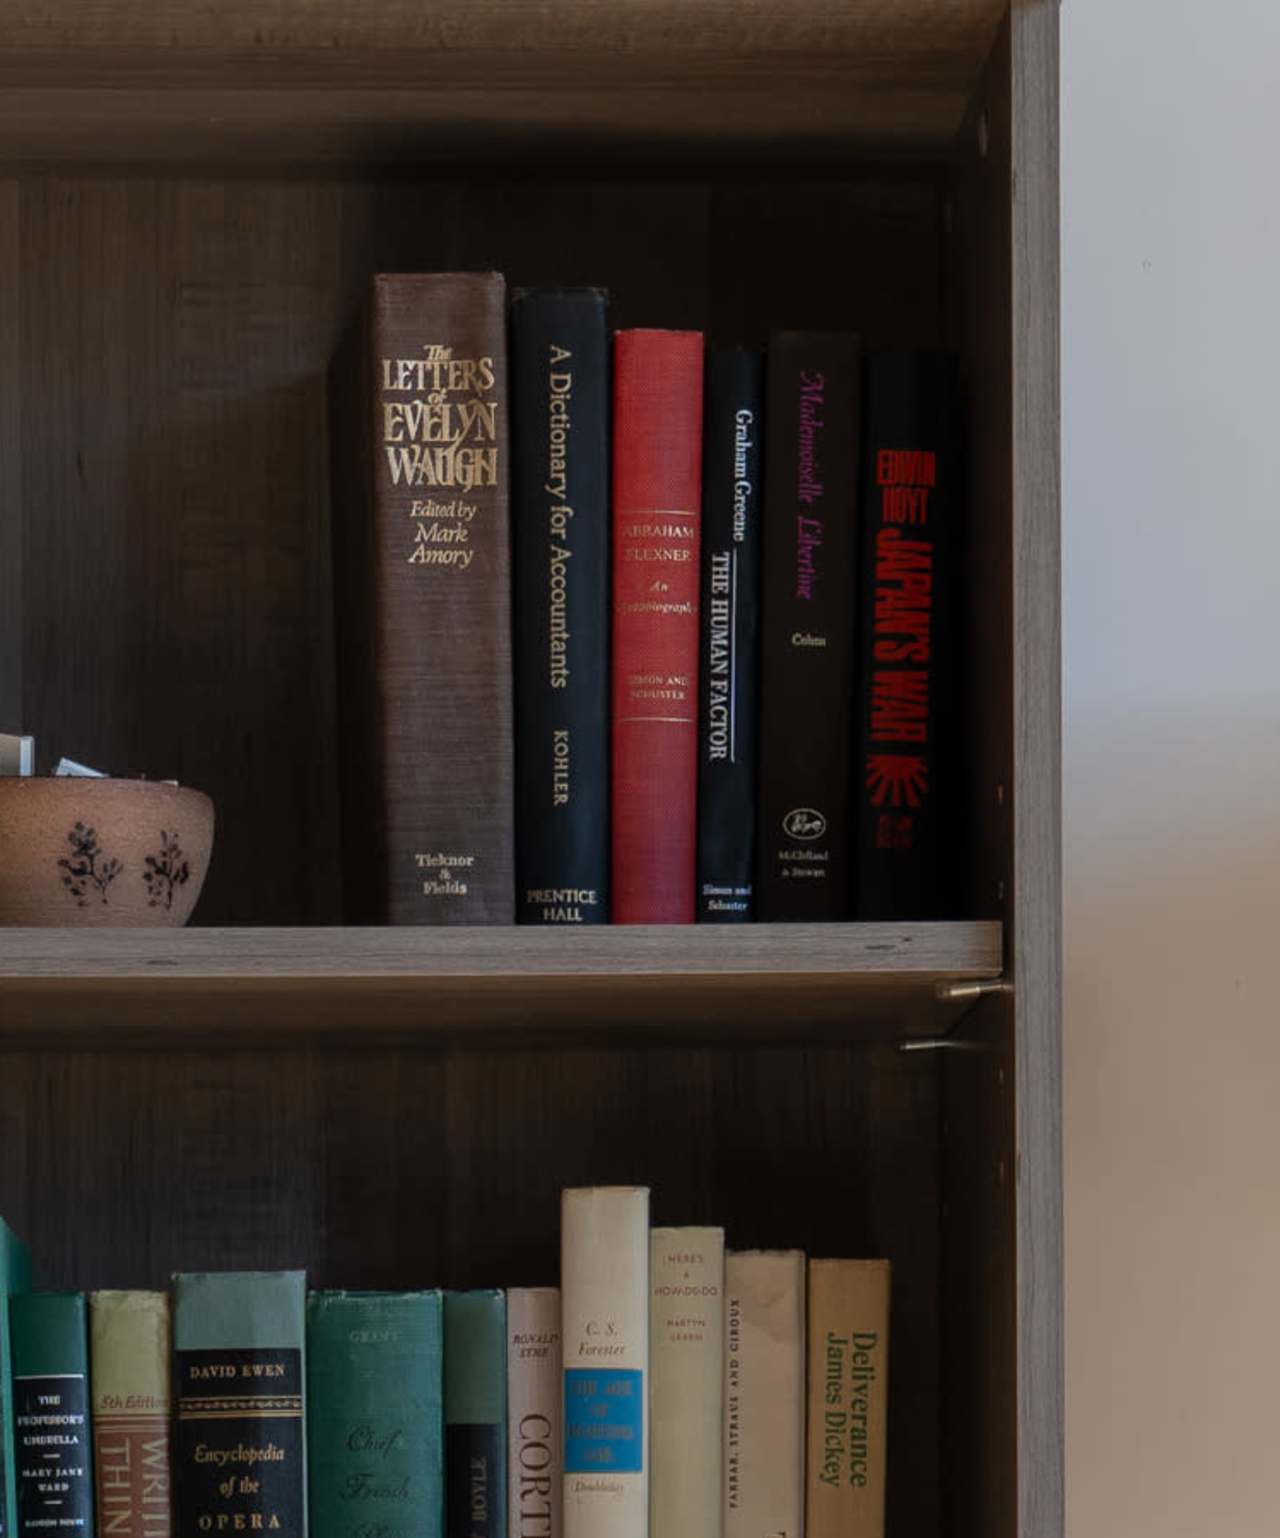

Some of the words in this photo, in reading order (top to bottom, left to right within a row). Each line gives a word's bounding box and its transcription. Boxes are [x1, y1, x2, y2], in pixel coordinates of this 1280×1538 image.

[423, 344, 454, 361] The
[549, 345, 572, 363] A
[381, 357, 496, 395] LETTERS
[382, 400, 498, 446] EVELYN
[544, 373, 572, 500] Dictionary
[735, 409, 752, 478] Graham
[798, 370, 824, 504] Mademoiselle
[385, 445, 499, 492] WAUGH
[409, 500, 454, 518] Edited
[455, 500, 477, 521] by
[550, 507, 575, 540] for
[623, 524, 694, 539] ABRAHAM
[732, 480, 752, 542] Greene
[414, 522, 469, 543] Mark
[408, 546, 474, 570] Amory
[624, 548, 692, 562] FLEXNER
[711, 551, 730, 594] THE
[795, 515, 822, 600] Libertine
[549, 545, 572, 689] Accountants
[710, 600, 729, 674] HUMAN
[709, 680, 728, 760] FACTOR
[871, 671, 928, 741] WAR
[553, 729, 569, 807] KOHLER
[410, 853, 474, 867] Ticknor
[527, 889, 597, 903] PRENTICE
[543, 907, 583, 922] HALL
[729, 1299, 740, 1353] GIROUX
[190, 1365, 236, 1379] DAVID
[242, 1364, 285, 1377] EWEN
[729, 1359, 739, 1387] AND
[824, 1333, 849, 1404] James
[850, 1332, 878, 1488] Deliverance
[194, 1444, 285, 1466] Encyclopedia
[820, 1411, 848, 1488] Dickey
[220, 1477, 237, 1498] of
[240, 1476, 260, 1494] the
[472, 1457, 487, 1520] BOYLE
[199, 1513, 281, 1530] OPERA
